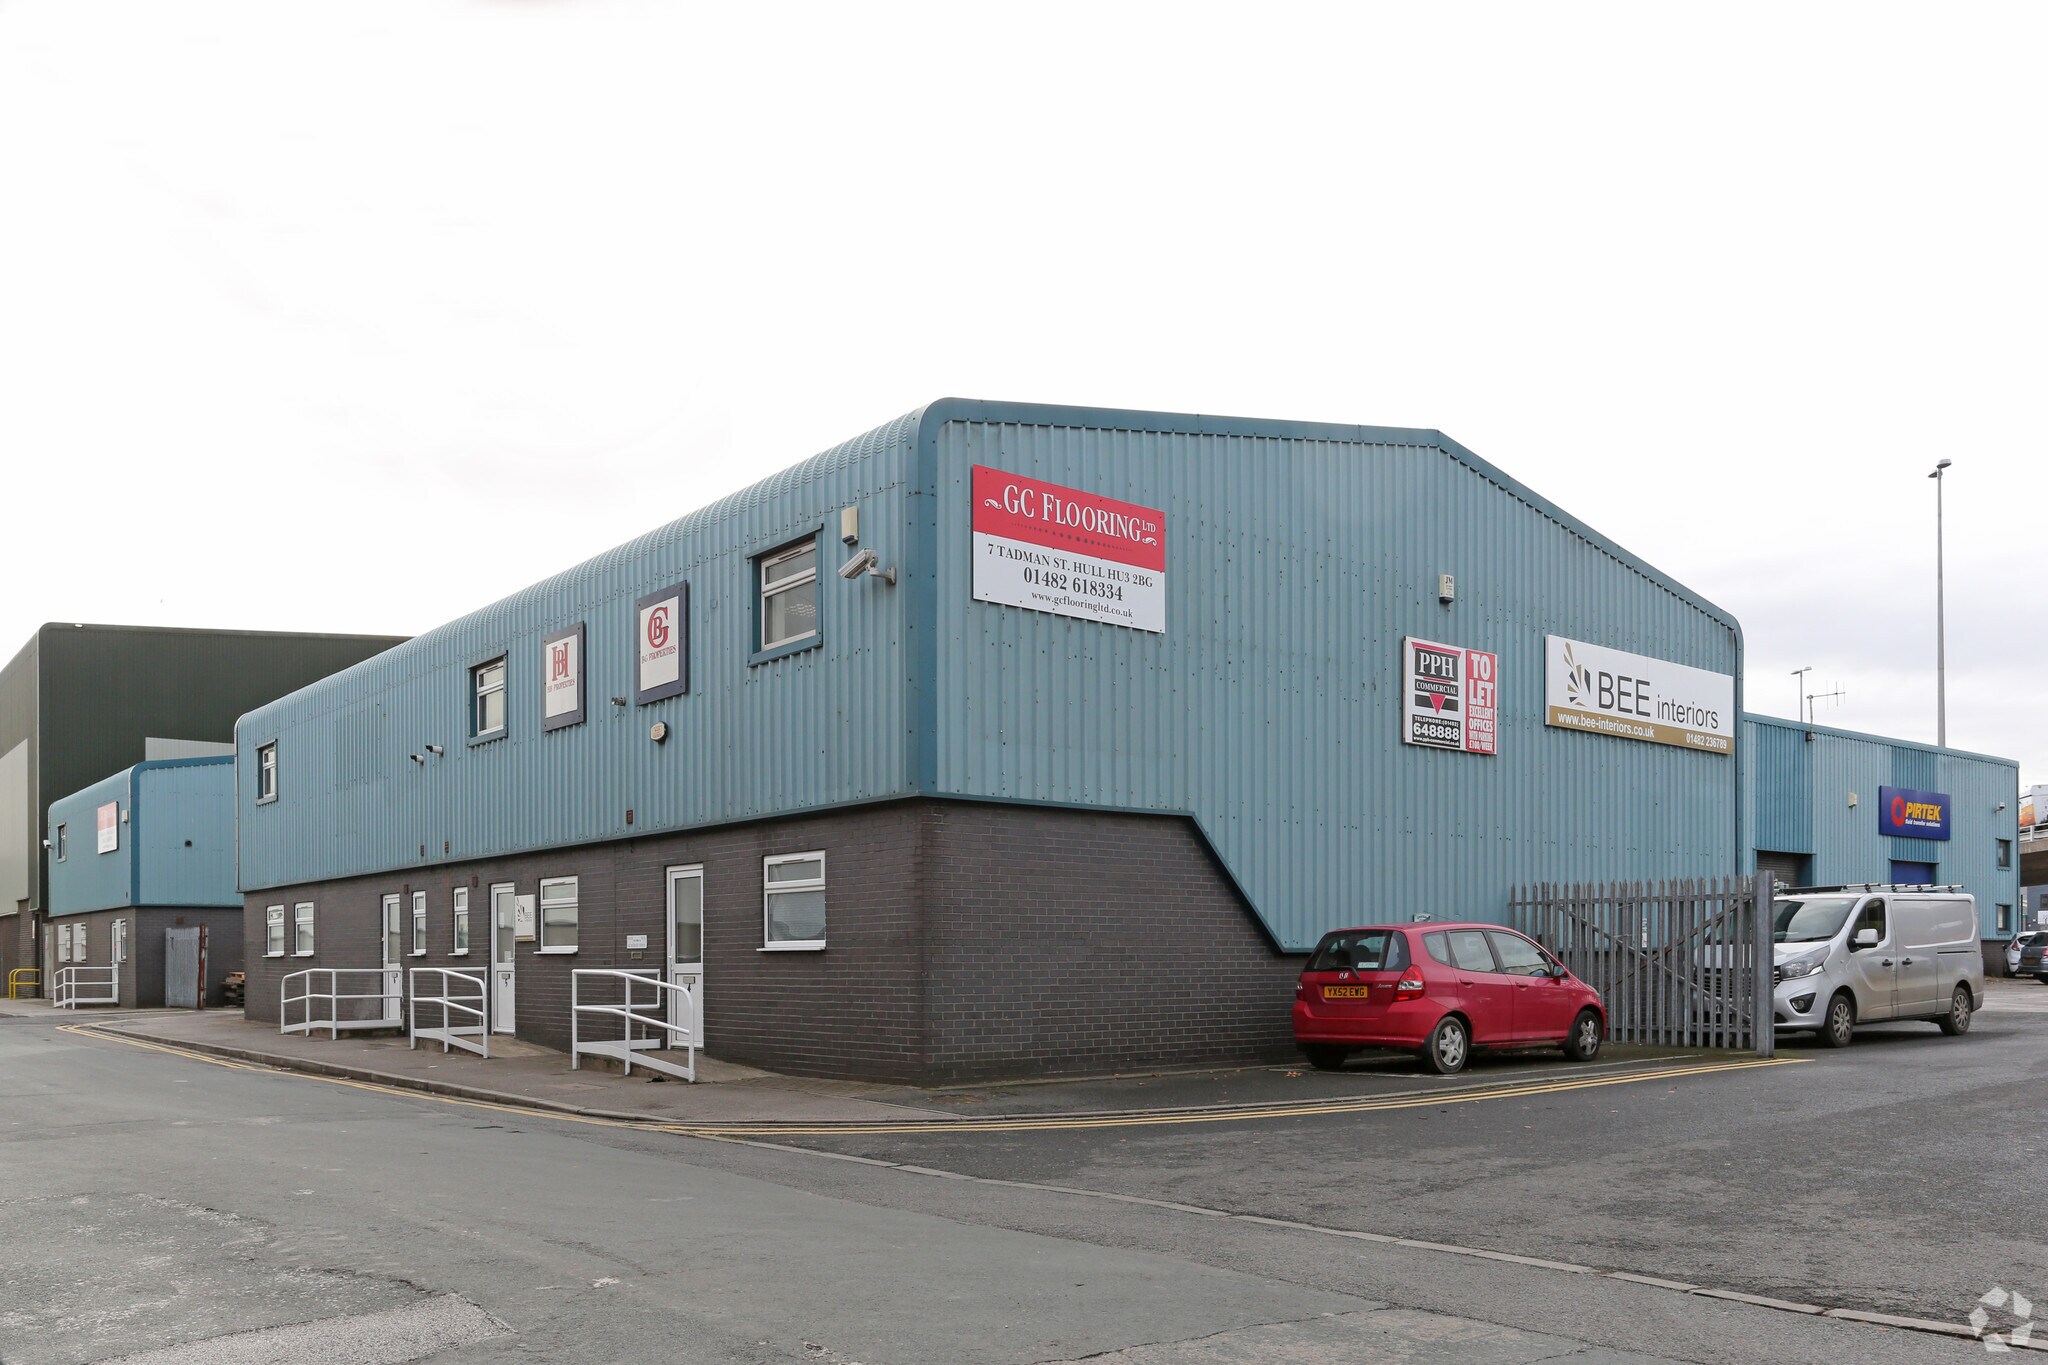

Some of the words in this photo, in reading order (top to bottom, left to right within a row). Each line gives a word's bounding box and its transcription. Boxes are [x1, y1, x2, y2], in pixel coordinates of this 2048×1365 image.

[1003, 484, 1035, 518] GC
[1041, 492, 1141, 542] FLOORING
[987, 543, 994, 555] 7
[997, 545, 1050, 567] TADMAN
[1053, 557, 1070, 572] ST.
[1073, 562, 1105, 579] HULL
[1107, 569, 1130, 584] HU3
[1132, 574, 1153, 588] 2BG
[1023, 566, 1067, 591] 01482
[1072, 576, 1123, 601] 618334
[1031, 591, 1133, 618] www.gcflooringltd.co.uk
[1419, 651, 1454, 678] PPH
[1471, 653, 1491, 680] TO
[1416, 681, 1457, 695] COMMERCIAL
[1469, 678, 1493, 707] LET
[1598, 671, 1651, 717] BEE
[1657, 694, 1719, 729] interiors
[1468, 718, 1493, 733] OFFICES
[1469, 705, 1493, 720] EXCELLENT
[1413, 723, 1460, 740] 648888
[1557, 712, 1655, 738] www.bee-interiors.co.uk
[1686, 732, 1704, 746] 01482
[1905, 802, 1941, 821] PIRTEK
[1327, 987, 1348, 997] YX52
[1349, 987, 1365, 997] EWG
